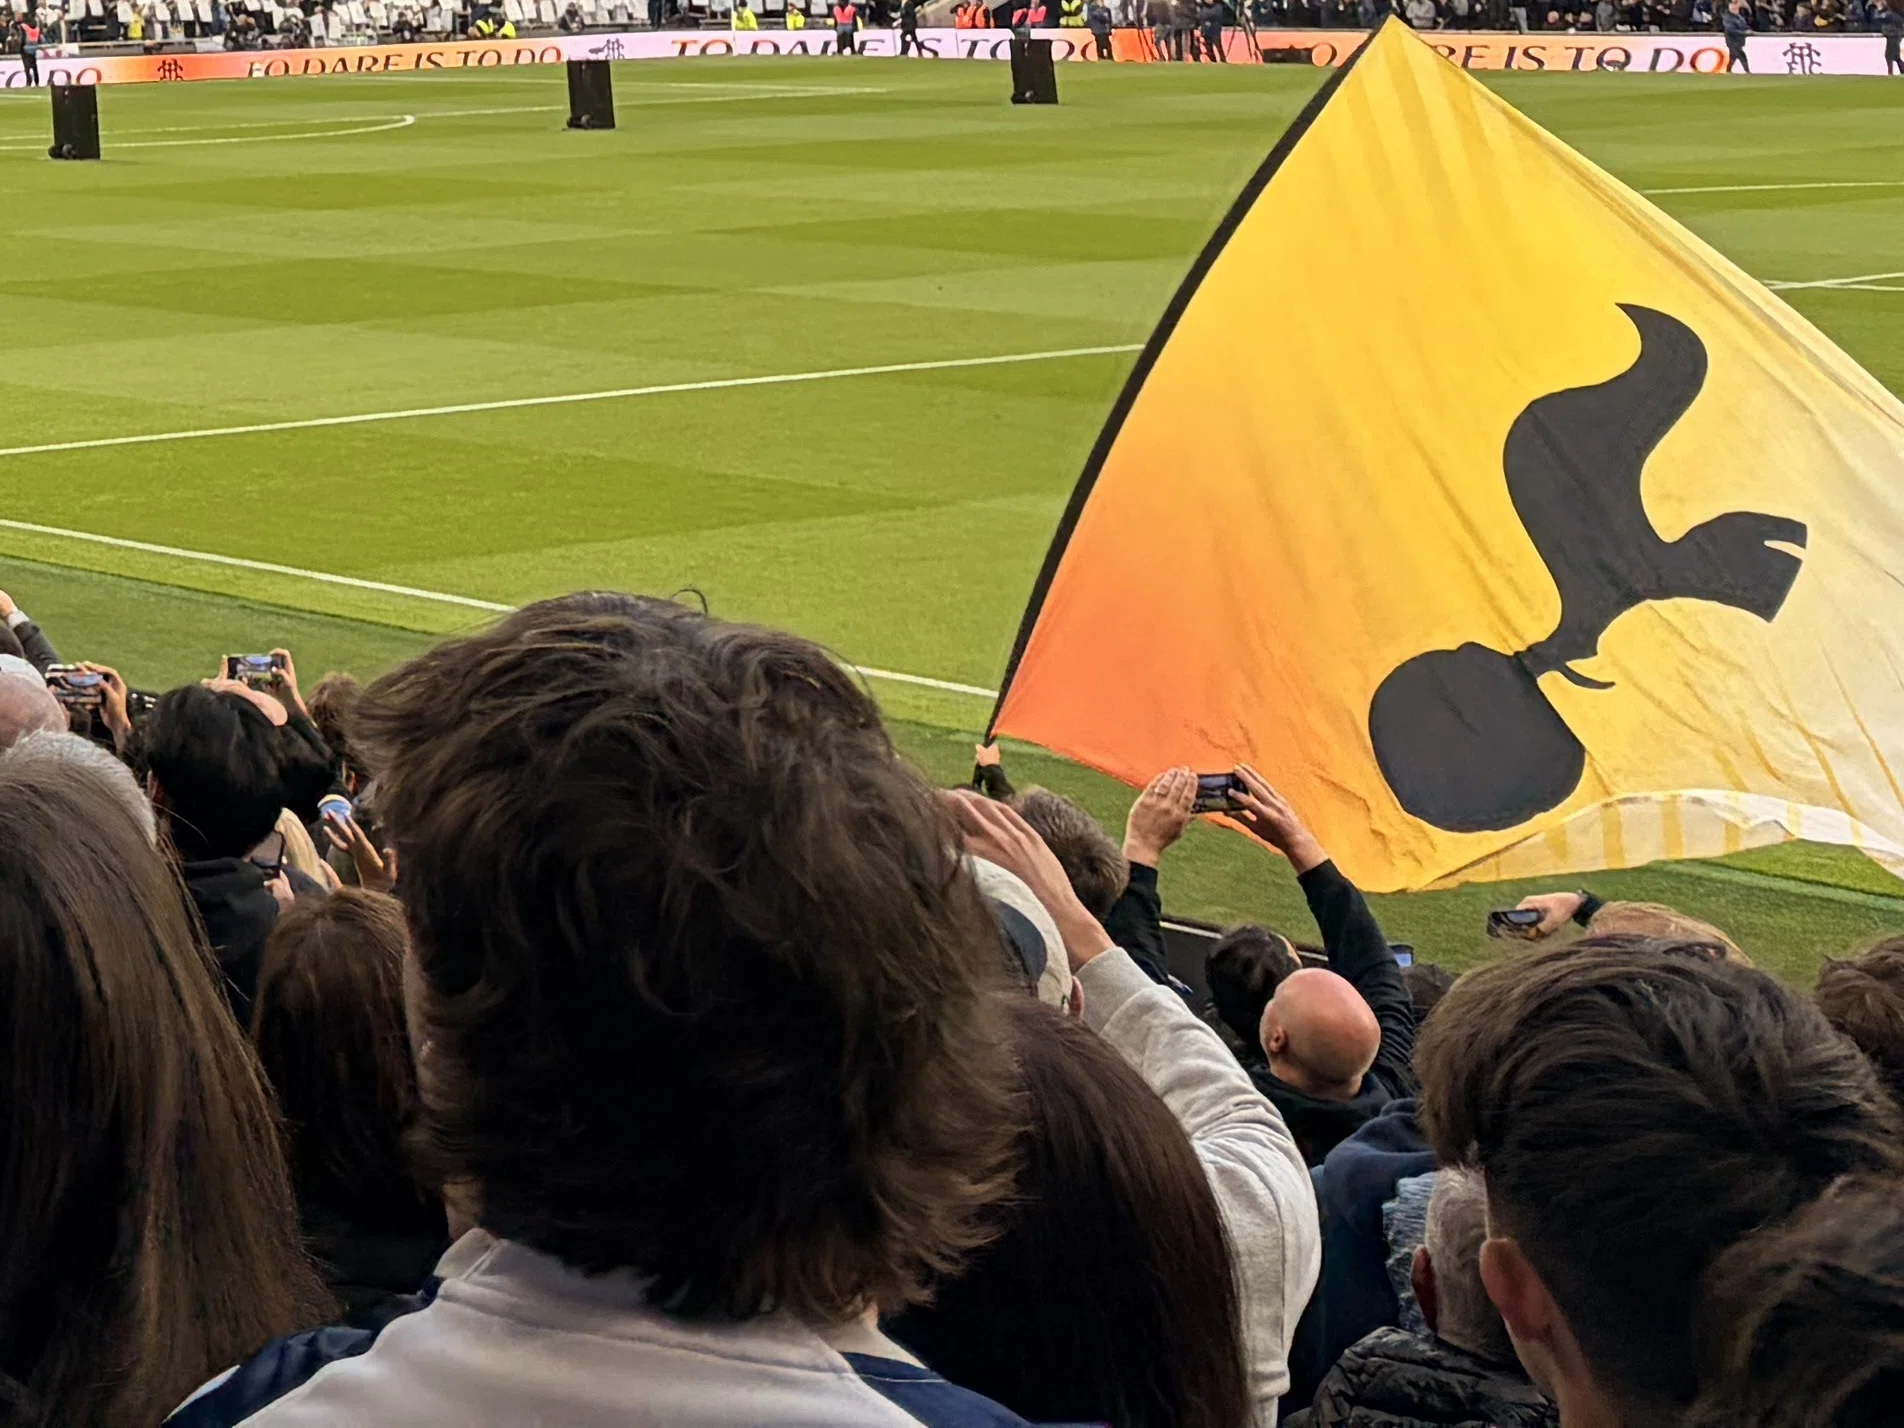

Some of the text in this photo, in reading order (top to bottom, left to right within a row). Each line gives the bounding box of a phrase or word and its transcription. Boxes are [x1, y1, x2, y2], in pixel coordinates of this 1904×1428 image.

[302, 53, 405, 77] DARE
[413, 50, 445, 70] IS
[456, 47, 503, 68] TO
[513, 45, 563, 64] DO
[670, 38, 733, 56] TO
[1501, 44, 1547, 71] IS
[1565, 45, 1632, 72] TO
[1648, 46, 1726, 74] DO
